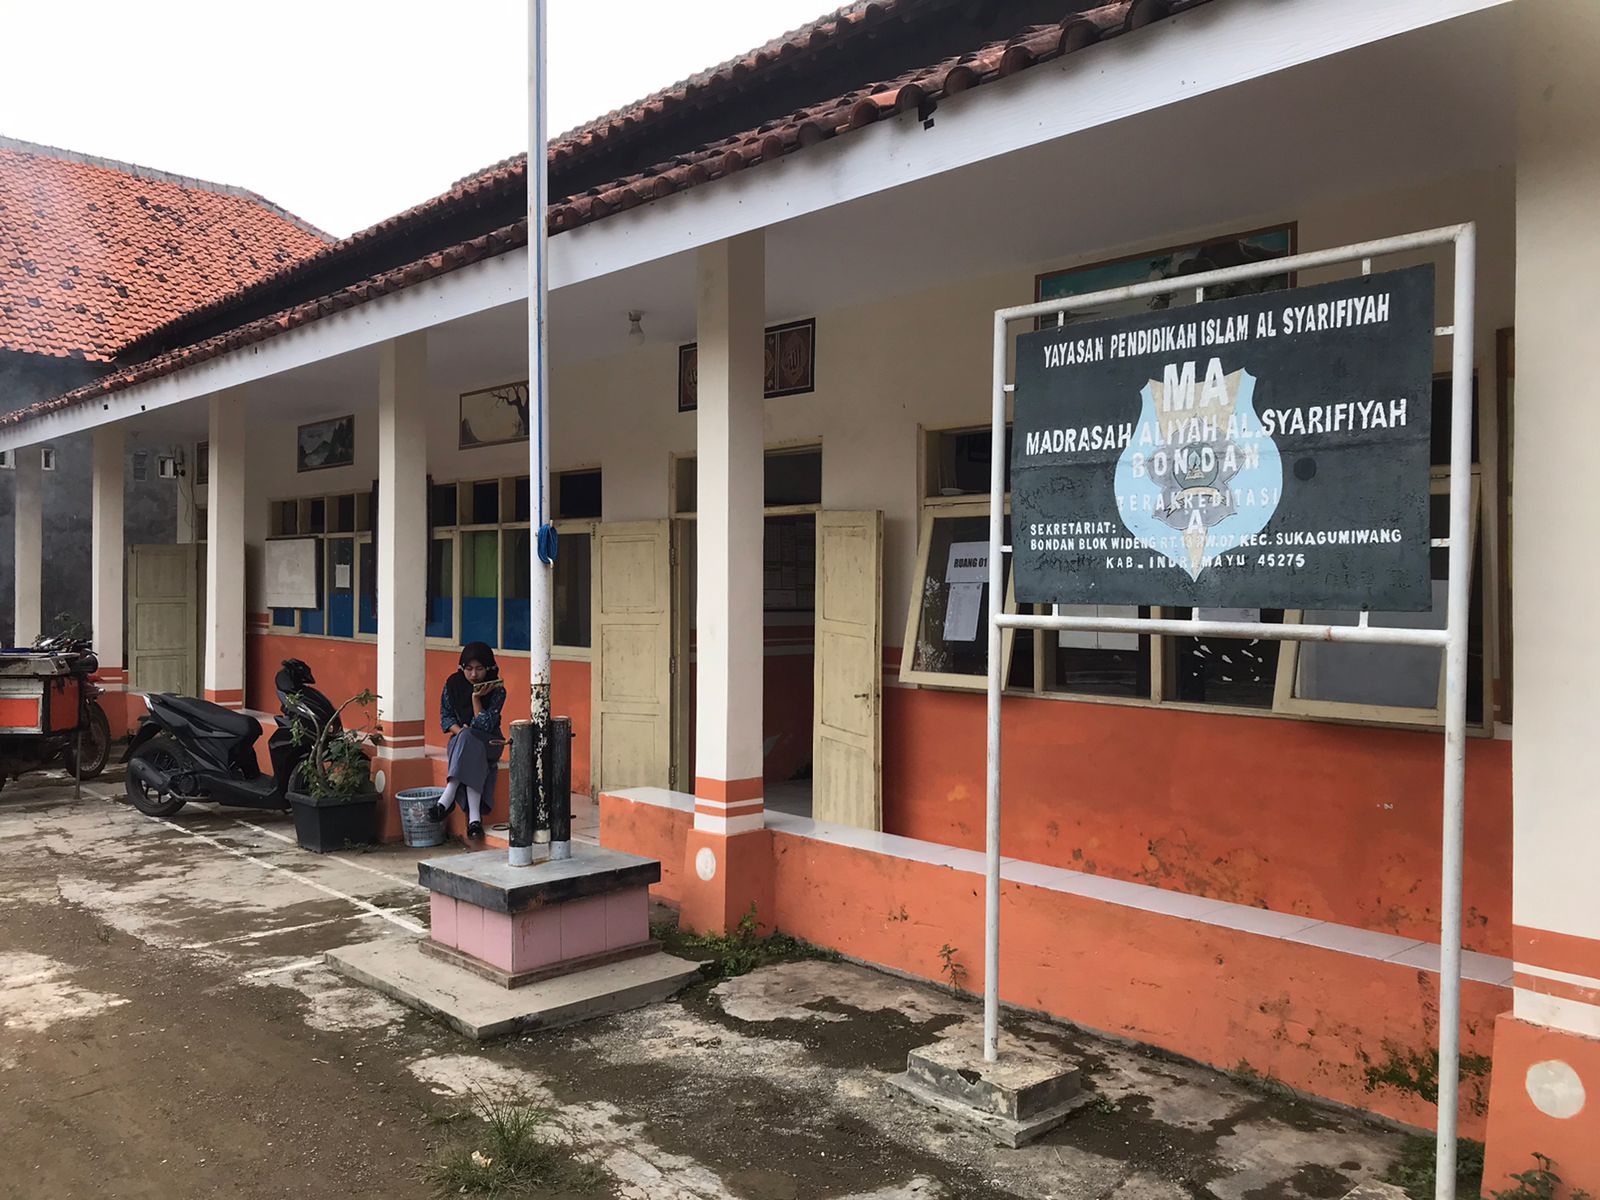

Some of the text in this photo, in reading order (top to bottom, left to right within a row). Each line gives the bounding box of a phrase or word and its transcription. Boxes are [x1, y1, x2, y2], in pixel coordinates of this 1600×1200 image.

[1044, 337, 1103, 369] YAYASAN
[1201, 314, 1249, 346] ISLAM
[1256, 310, 1276, 339] AL
[1283, 293, 1390, 335] SYARIFIYAH
[1162, 357, 1229, 413] MA
[1026, 422, 1132, 456] MADRASAH
[1139, 415, 1217, 447] ALIYAH
[1132, 442, 1260, 478] BONDAN
[1117, 487, 1278, 512] TERAKREDITASI
[1030, 521, 1117, 536] SEKRETARIAT:
[1030, 538, 1075, 551] BONDAN
[1079, 537, 1107, 550] BLOK
[1111, 536, 1156, 550] WIDENG
[1240, 533, 1272, 547] KEC.
[1276, 529, 1402, 546] SUKAGUMIWANG
[1258, 553, 1306, 568] 45275
